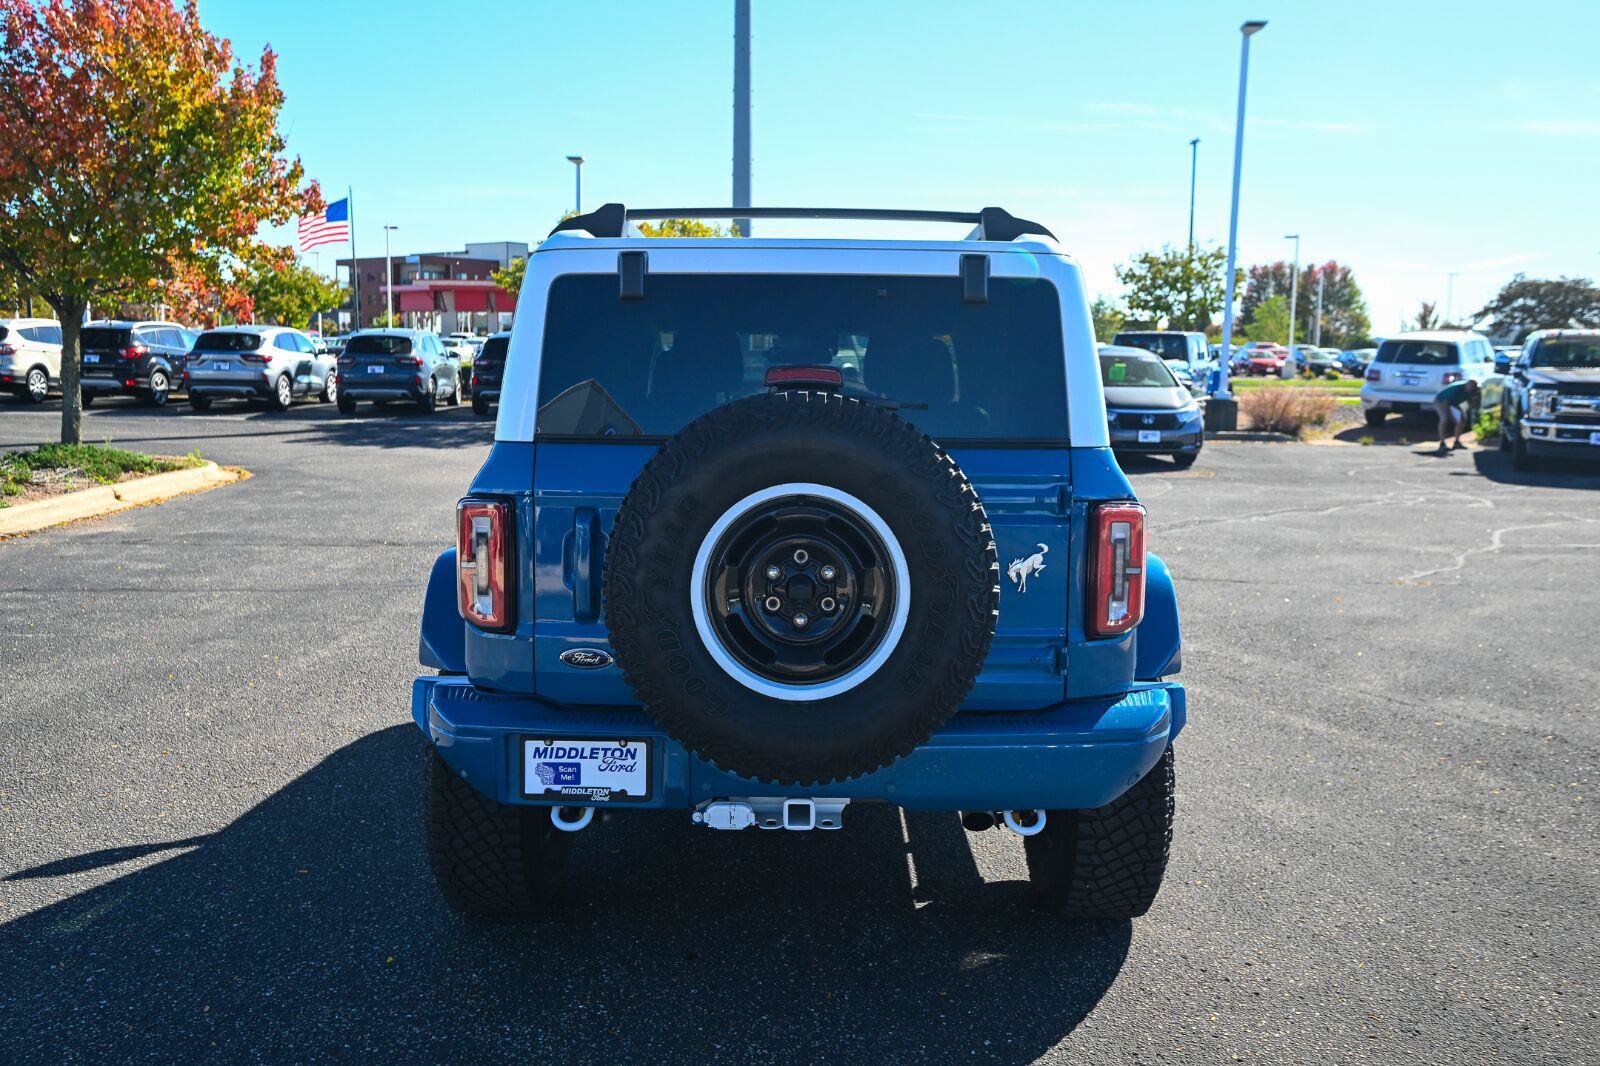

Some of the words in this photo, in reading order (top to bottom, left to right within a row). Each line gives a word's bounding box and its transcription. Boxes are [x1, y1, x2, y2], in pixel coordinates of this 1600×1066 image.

[572, 651, 601, 664] Ford
[533, 746, 638, 760] MIDDLETON
[598, 756, 638, 773] Ford
[561, 787, 610, 795] MIDDLETON
[591, 794, 610, 802] Ford
